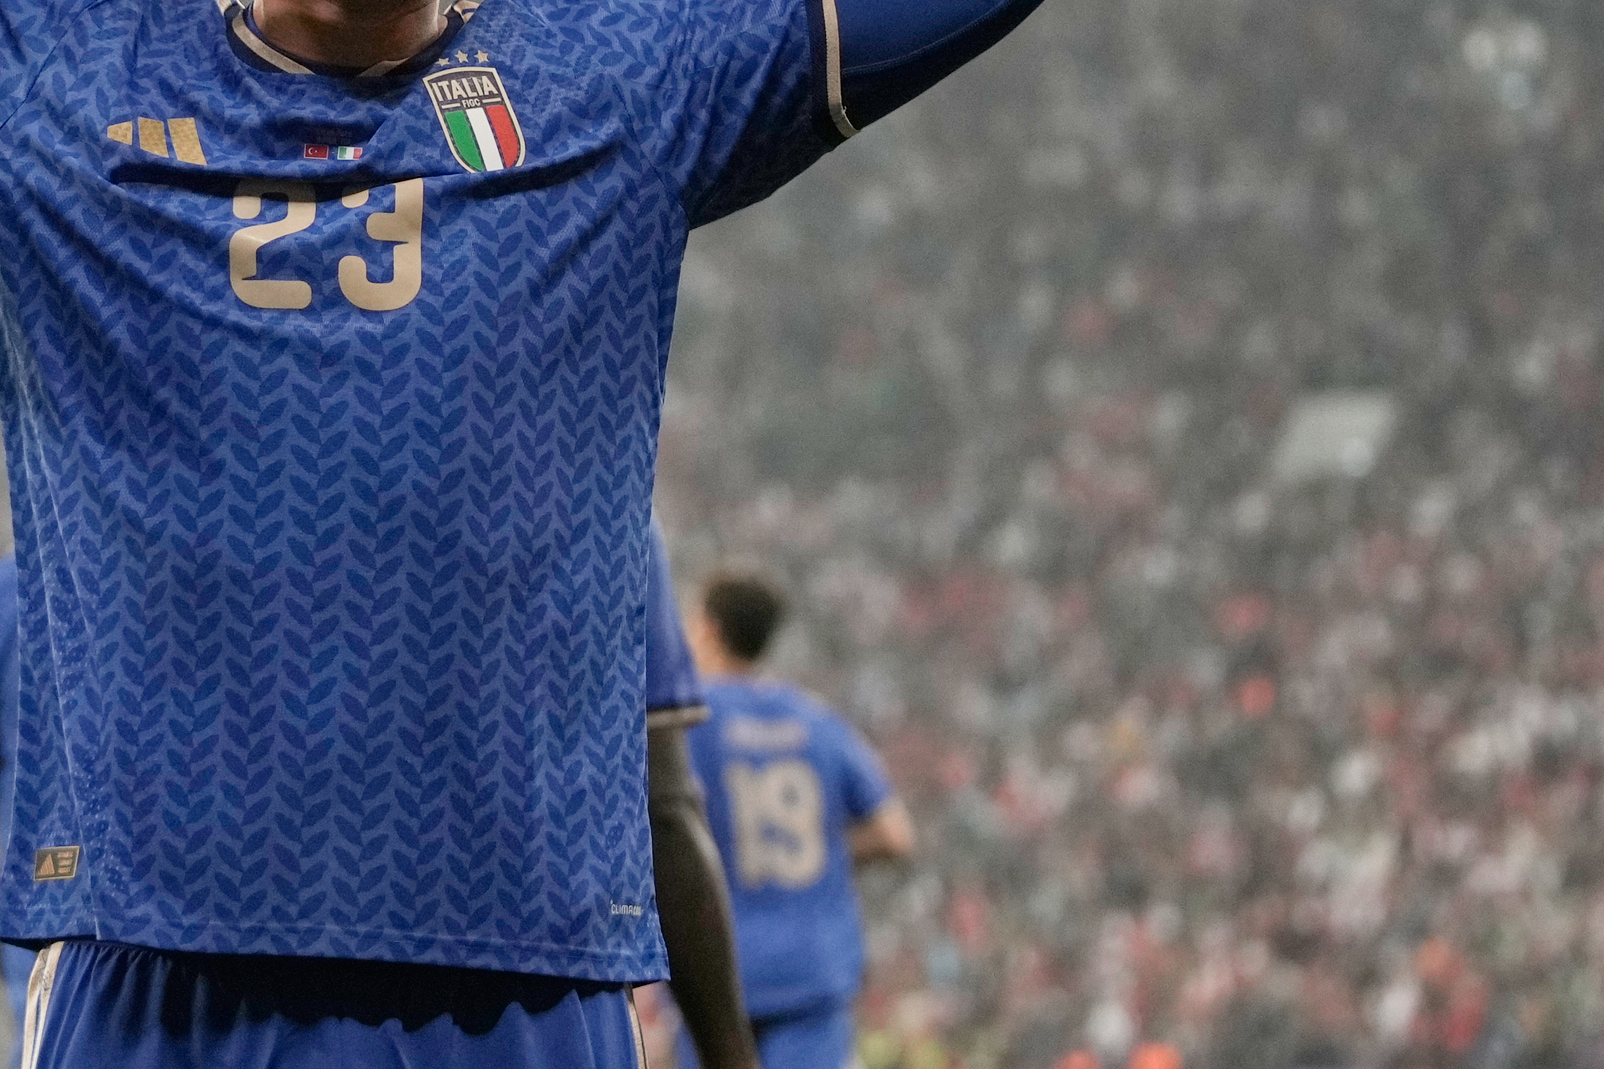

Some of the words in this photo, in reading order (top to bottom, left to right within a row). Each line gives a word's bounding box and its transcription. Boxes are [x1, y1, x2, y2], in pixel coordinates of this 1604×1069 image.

[431, 75, 499, 102] ITALIA
[461, 98, 481, 109] FIGC
[229, 178, 424, 311] 23
[725, 759, 826, 887] 19
